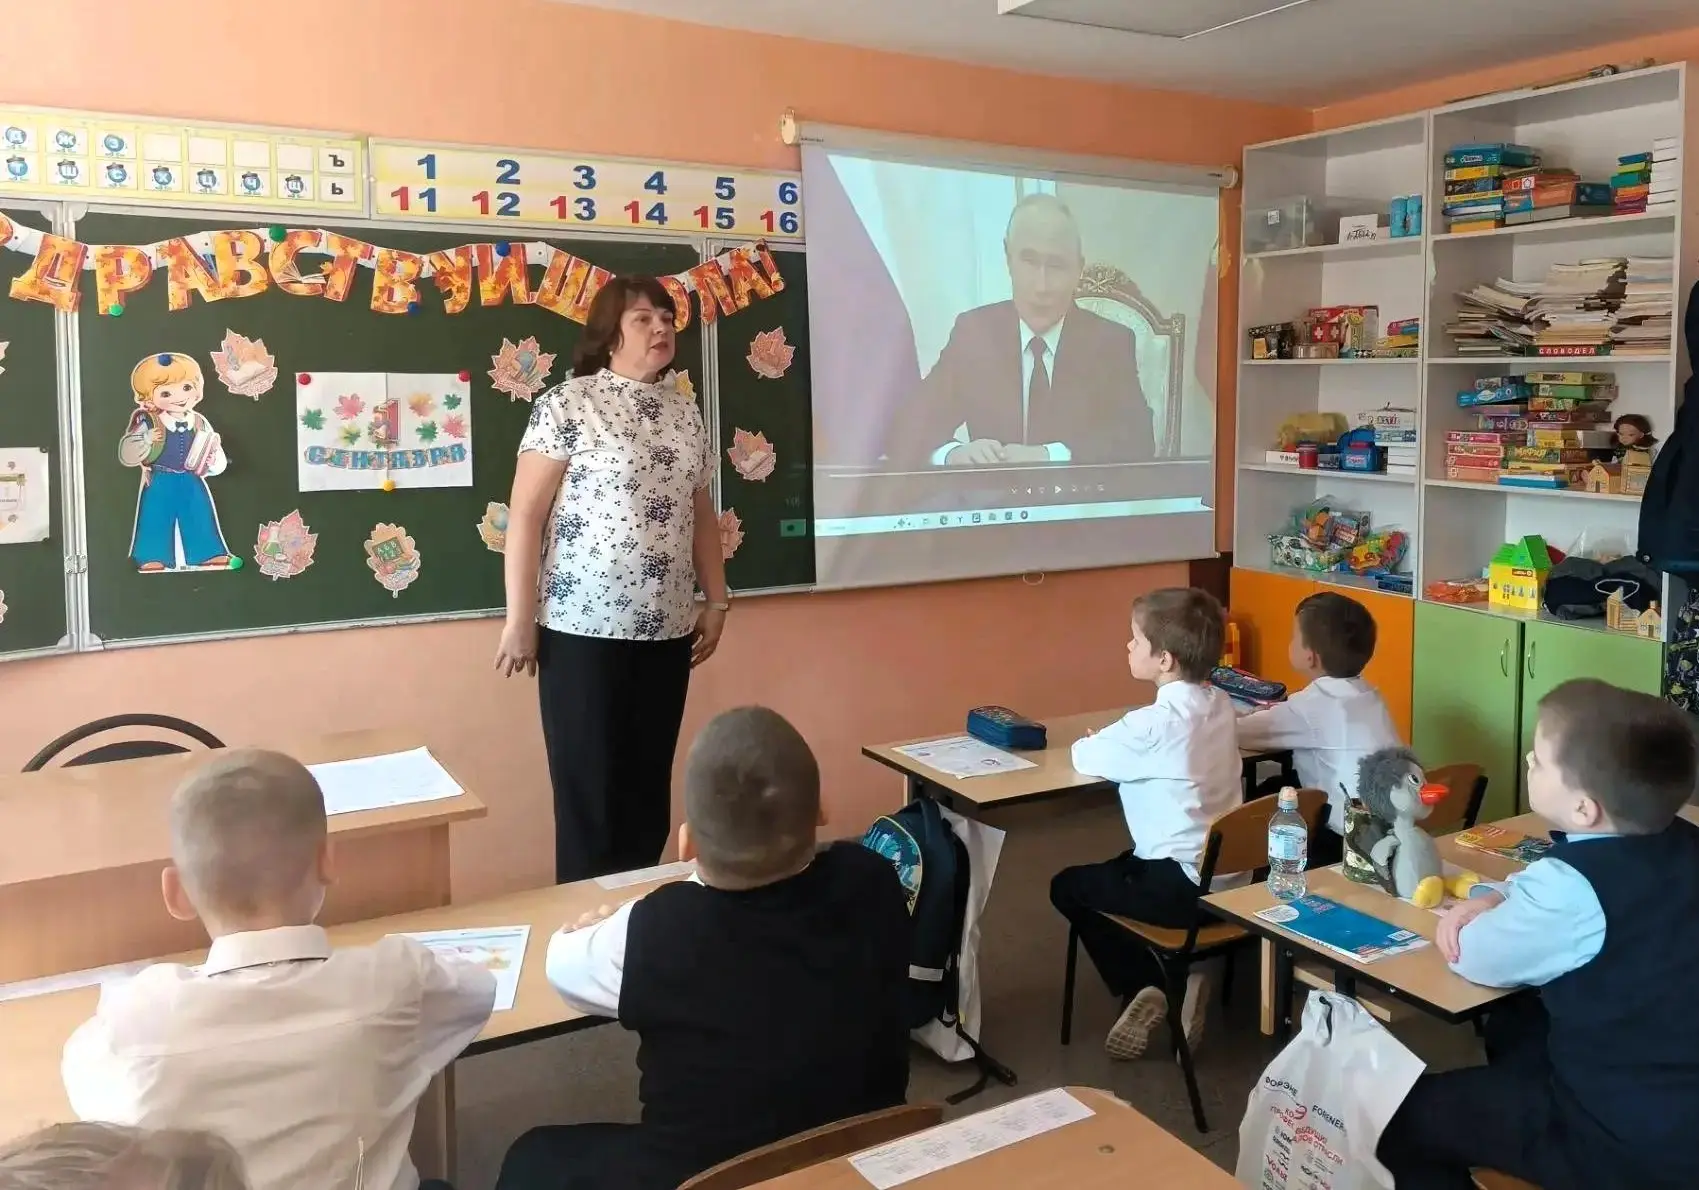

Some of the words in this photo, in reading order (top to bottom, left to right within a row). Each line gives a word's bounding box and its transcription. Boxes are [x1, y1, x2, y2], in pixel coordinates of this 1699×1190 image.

[417, 154, 436, 179] 1
[496, 159, 521, 185] 2
[573, 165, 596, 190] 3
[644, 171, 668, 195] 4
[714, 176, 736, 200] 5
[778, 182, 798, 205] 6
[391, 186, 437, 212] 11
[472, 191, 521, 216] 12
[550, 196, 596, 221] 13
[624, 201, 668, 225] 14
[693, 205, 736, 229] 15
[760, 210, 798, 233] 16
[1539, 347, 1596, 356] СЛОВОДЕЛ
